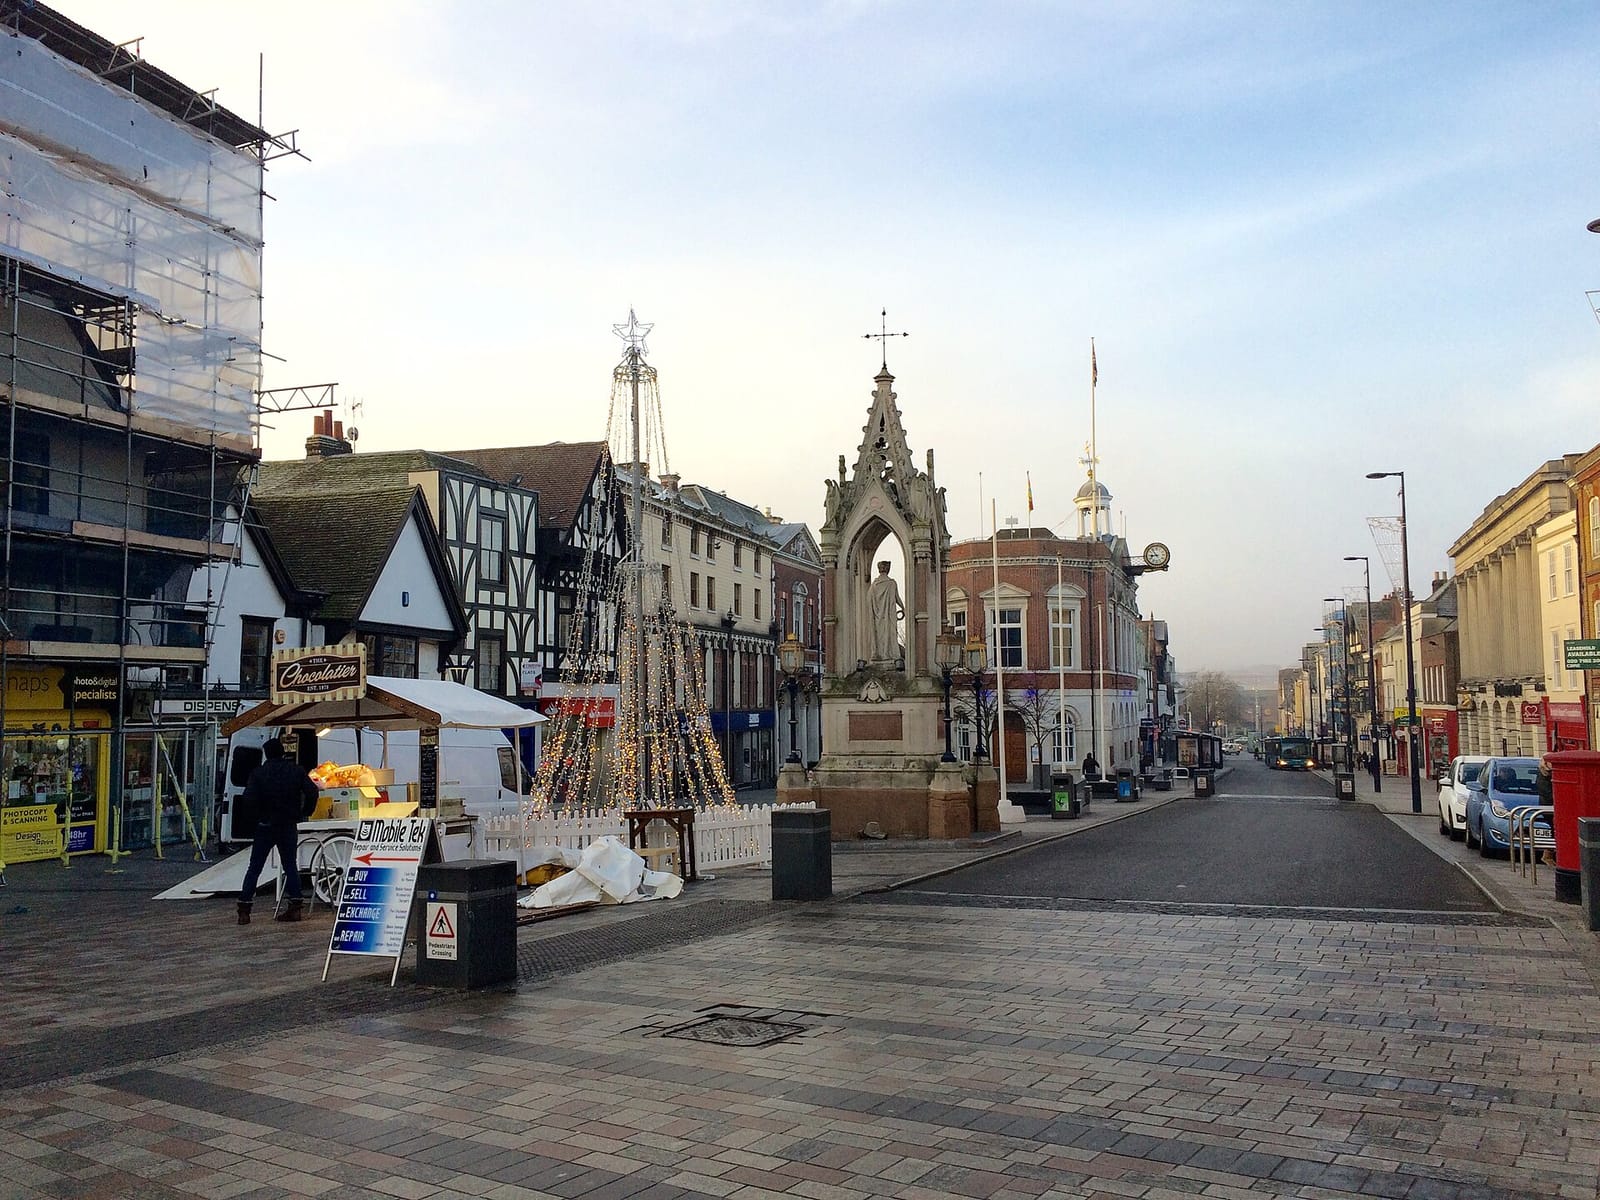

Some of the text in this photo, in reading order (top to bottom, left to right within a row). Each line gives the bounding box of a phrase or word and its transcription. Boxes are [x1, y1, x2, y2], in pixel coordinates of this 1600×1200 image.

[280, 662, 357, 688] Chocolatier
[0, 675, 50, 698] naps
[74, 689, 117, 703] pecialists
[3, 808, 48, 818] PHOTOCOPY
[10, 816, 48, 825] SCANNING
[16, 832, 41, 842] Design
[372, 819, 426, 843] Mobile Tek
[354, 842, 369, 852] Repair
[370, 843, 379, 851] and
[380, 843, 398, 851] Service
[354, 870, 369, 881] BUY
[350, 888, 367, 900] SELL
[345, 906, 382, 919] EXCHANGE
[340, 930, 365, 942] REPAIR
